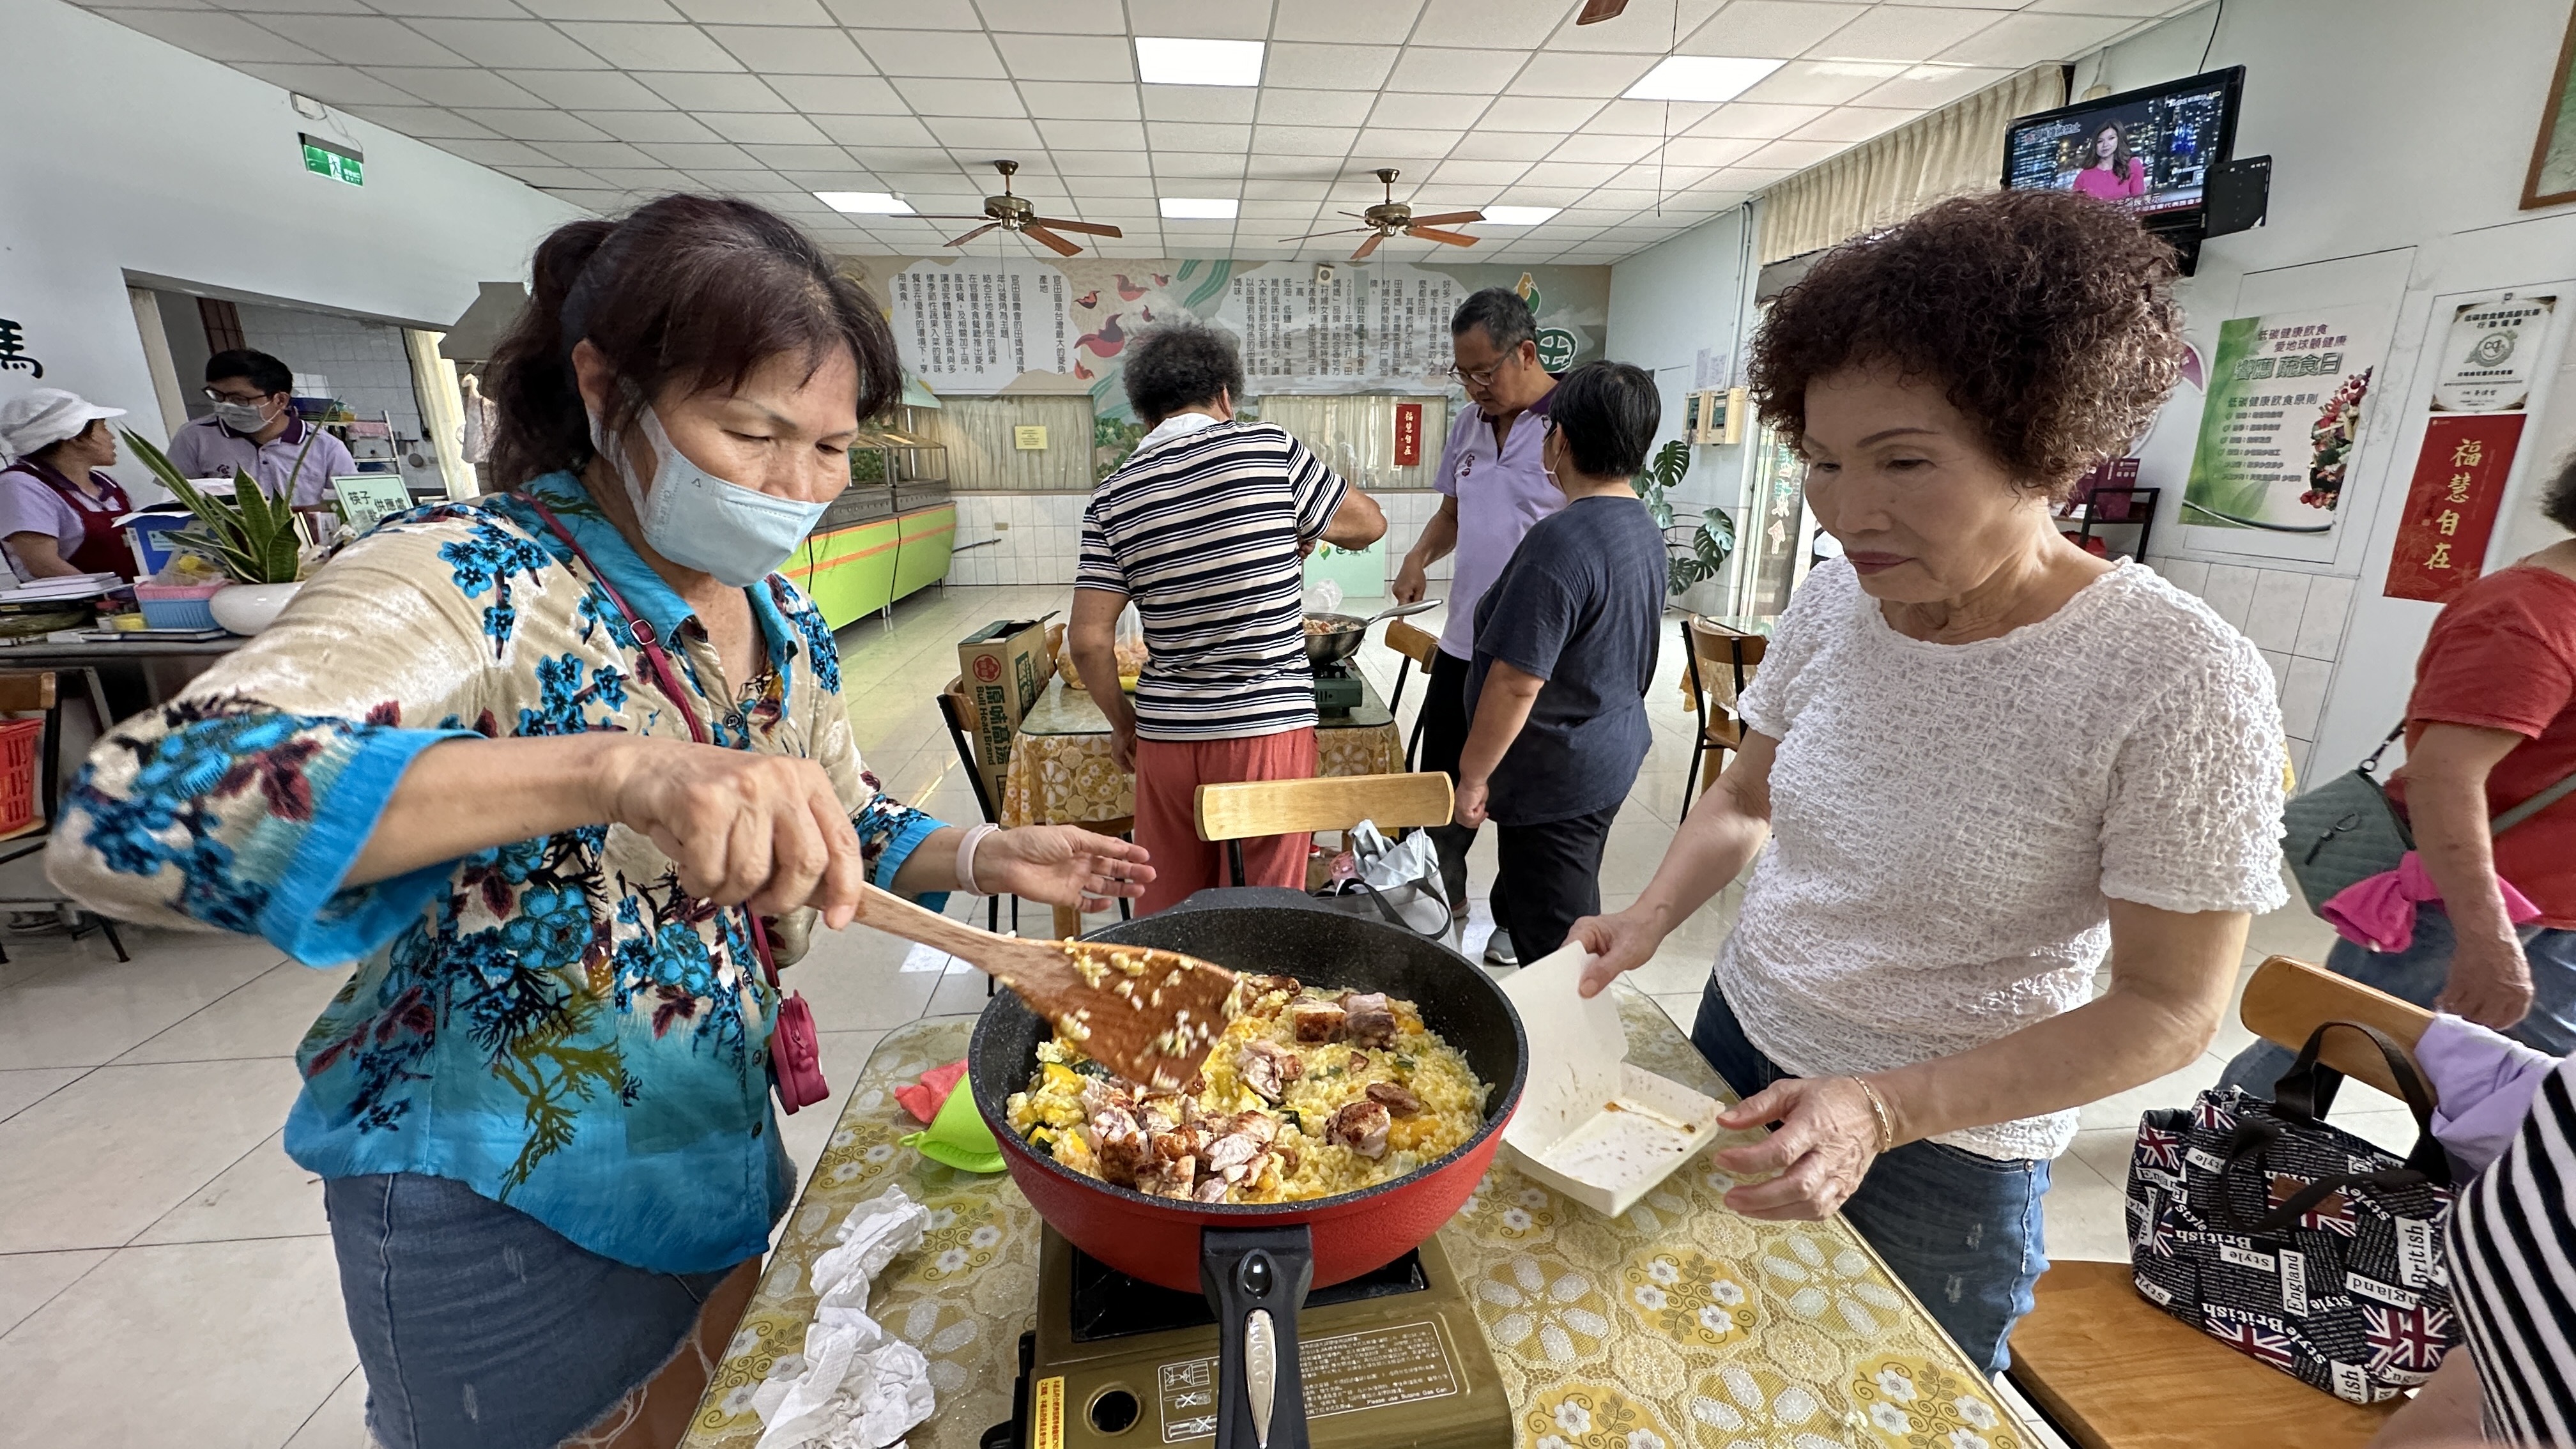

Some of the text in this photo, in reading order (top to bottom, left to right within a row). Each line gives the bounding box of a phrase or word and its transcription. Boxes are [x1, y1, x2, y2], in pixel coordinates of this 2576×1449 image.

[1039, 275, 1048, 293] 產地
[1296, 281, 1305, 296] 一高
[926, 274, 942, 373] 樣季節性蔬果入菜的風味
[940, 274, 956, 373] 讓遊客體驗官田菱角與多
[1053, 275, 1066, 374] 官田區是台灣最大的菱角
[1320, 285, 1329, 375] 村婦女運用當地特有農
[2257, 323, 2329, 341] 低碳健康飲食
[2274, 335, 2348, 353] 愛地球顧健康
[2276, 353, 2344, 379] 蔬食日
[2228, 393, 2319, 408] 低碳健康飲食原則
[348, 491, 371, 505] 筷子
[2423, 438, 2483, 570] 福慧自在
[976, 686, 996, 765] Bull Head Brand
[985, 685, 1011, 765] 原味高湯
[2175, 1204, 2207, 1231] Style
[2350, 1188, 2391, 1221] Style
[2175, 1230, 2252, 1250] British
[2405, 1224, 2429, 1284] British
[2230, 1250, 2269, 1267] Style
[2287, 1254, 2305, 1314] England
[2353, 1277, 2419, 1305] ngland
[2310, 1295, 2353, 1312] Style
[2202, 1303, 2285, 1333] British
[2285, 1326, 2326, 1364] Style
[1436, 1386, 1448, 1395] Can
